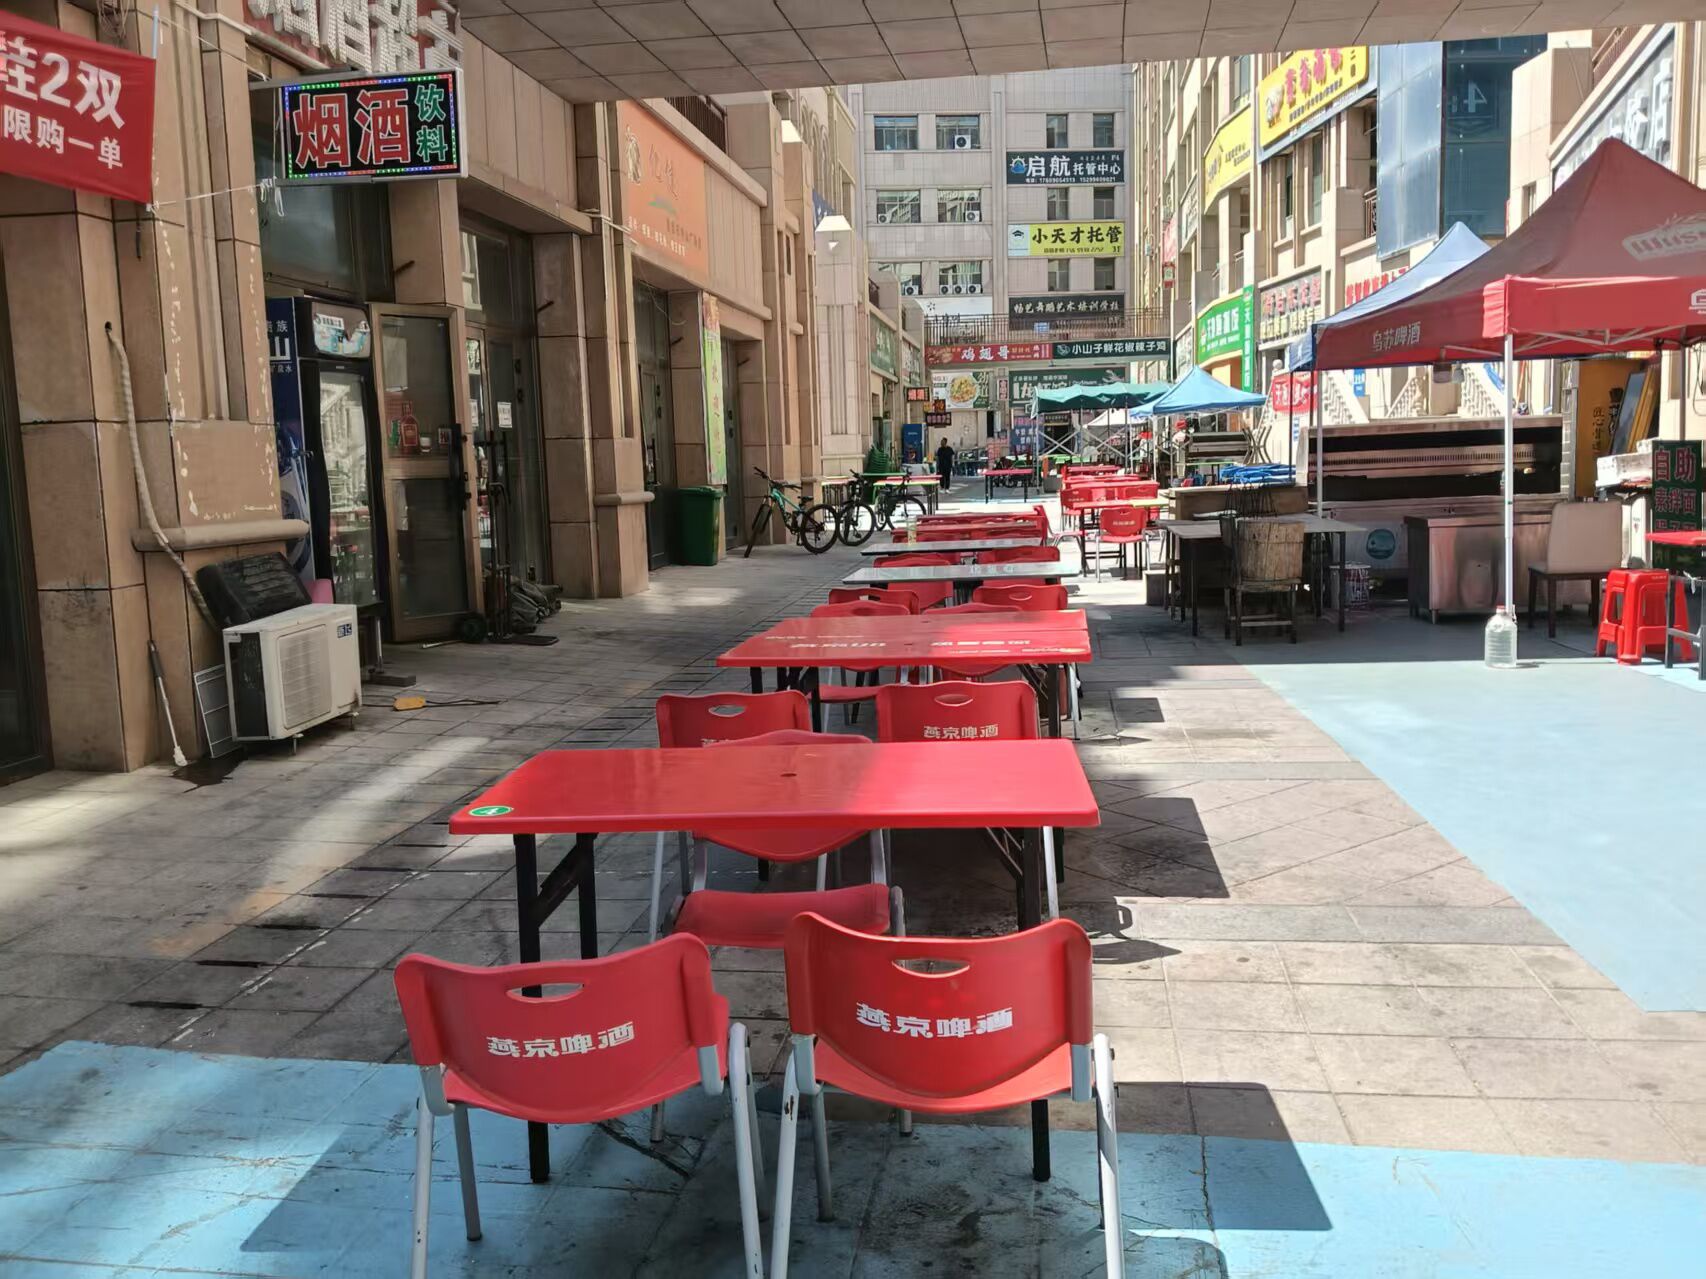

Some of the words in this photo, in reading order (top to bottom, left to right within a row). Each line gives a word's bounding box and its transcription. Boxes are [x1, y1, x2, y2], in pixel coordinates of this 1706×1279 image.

[2, 104, 124, 170] 限购一单
[293, 88, 412, 169] 烟酒
[414, 83, 449, 164] 饮料
[1032, 225, 1123, 244] 小天才托管
[1071, 340, 1168, 356] 小山子鲜花椒辣子鸡
[1372, 320, 1422, 352] 乌苏啤酒
[1653, 446, 1697, 483] 自助
[923, 723, 999, 740] 燕京啤酒
[855, 1001, 1014, 1039] 燕京啤酒
[486, 1021, 635, 1058] 燕京啤酒
